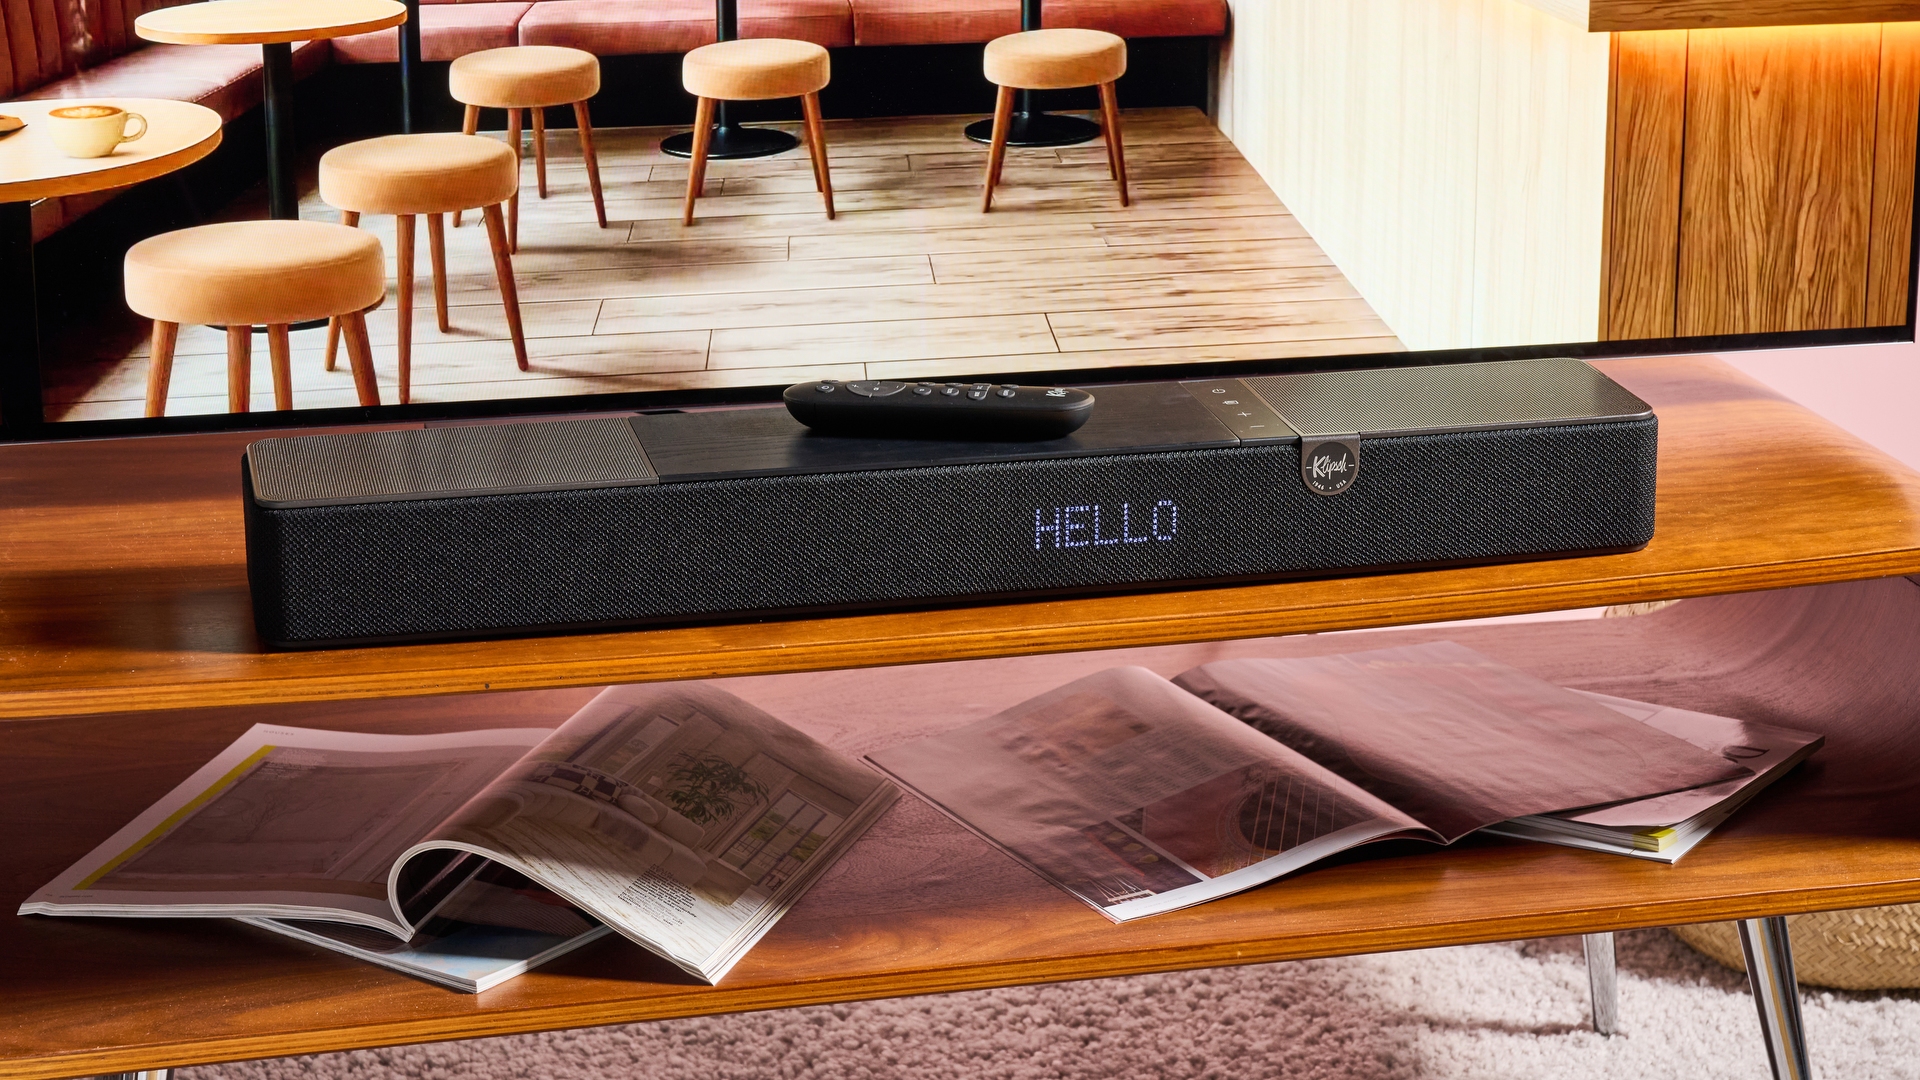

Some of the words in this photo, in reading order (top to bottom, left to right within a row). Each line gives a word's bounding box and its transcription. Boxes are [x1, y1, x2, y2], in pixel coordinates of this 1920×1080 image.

[1312, 453, 1347, 480] Klipsch
[1312, 480, 1325, 490] 1946
[1336, 479, 1347, 489] USA
[1035, 500, 1177, 549] HELLO
